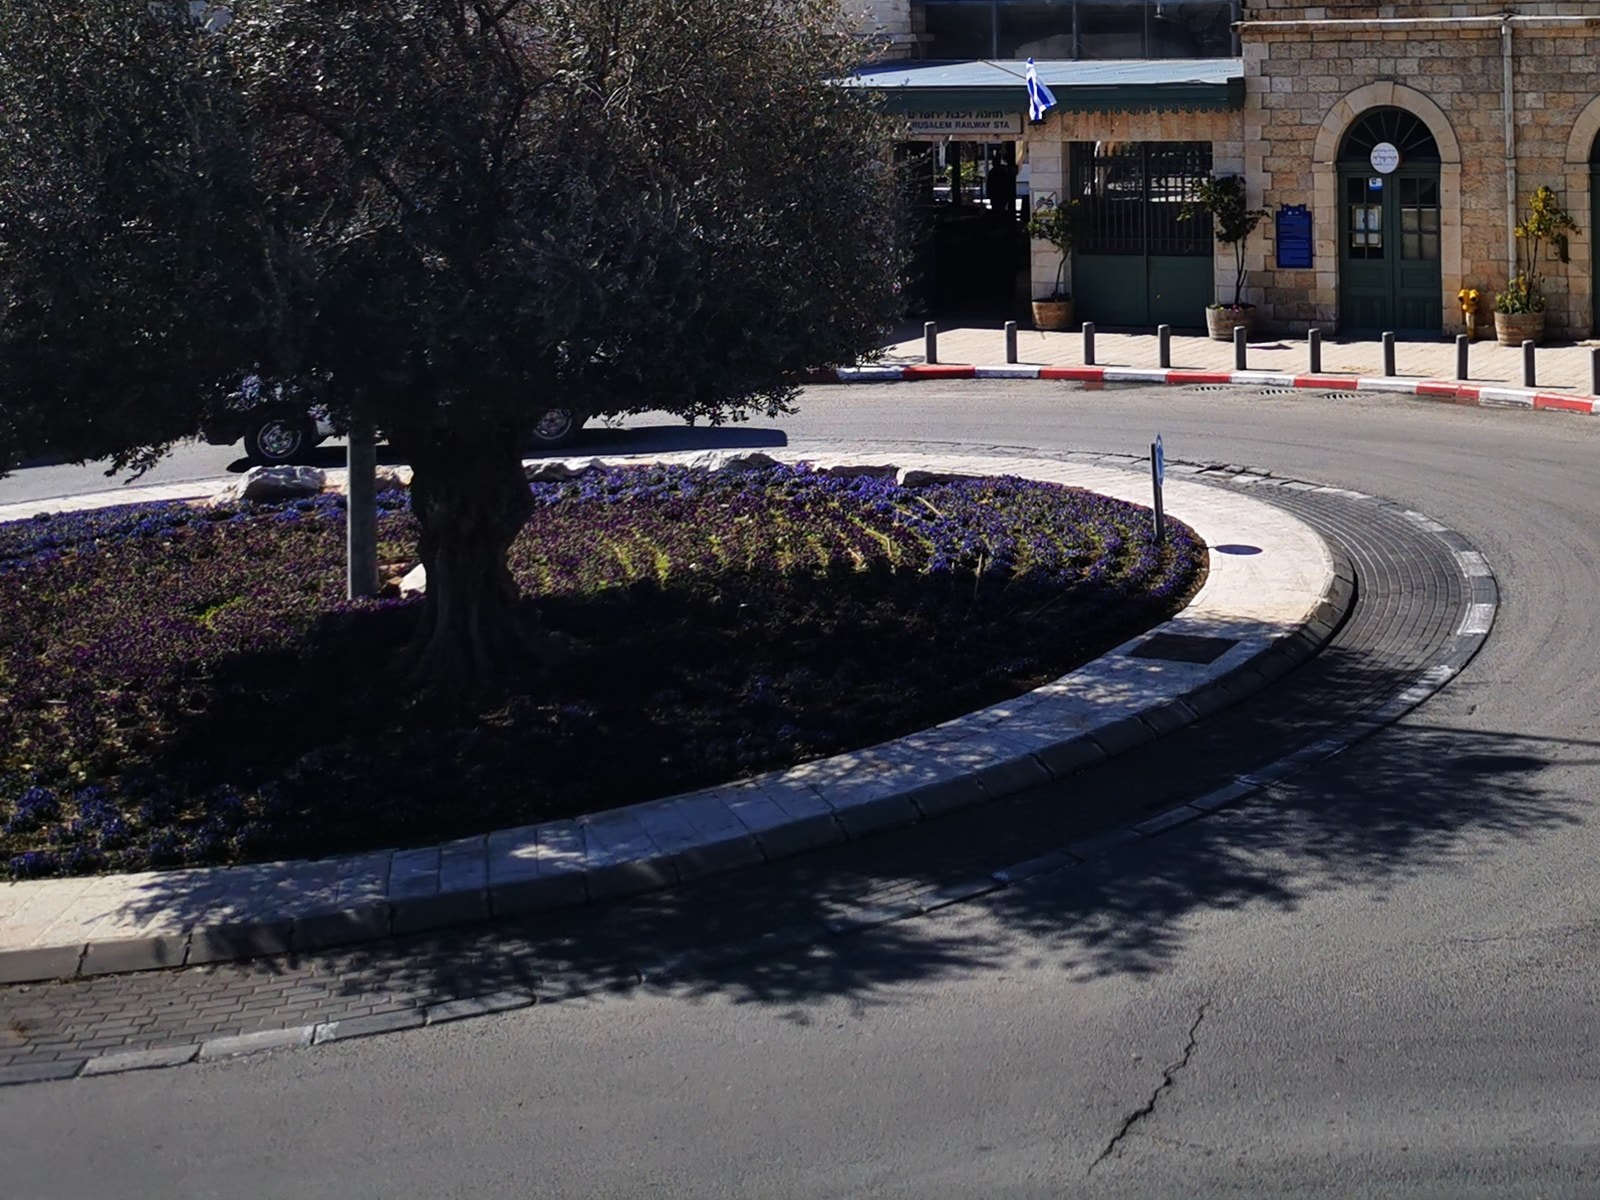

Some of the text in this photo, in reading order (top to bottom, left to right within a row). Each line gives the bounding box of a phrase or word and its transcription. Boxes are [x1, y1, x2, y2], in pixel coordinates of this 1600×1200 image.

[911, 120, 1010, 130] RUSALEM RAILWAY STA
